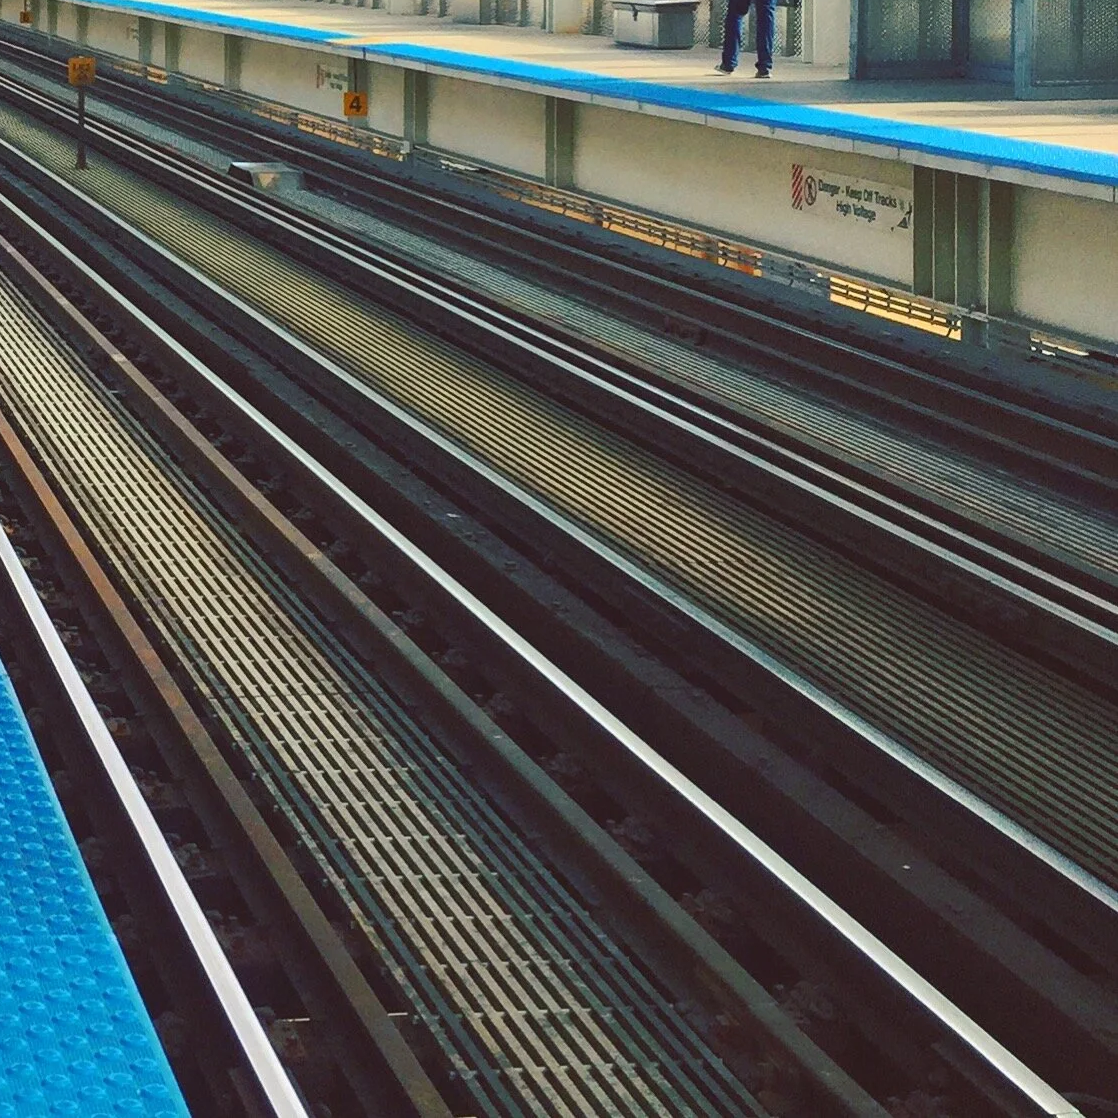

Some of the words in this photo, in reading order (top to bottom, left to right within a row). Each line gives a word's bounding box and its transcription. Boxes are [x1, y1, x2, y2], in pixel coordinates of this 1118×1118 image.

[349, 95, 362, 113] 4
[818, 179, 840, 197] Danger
[846, 185, 862, 202] Keep
[864, 189, 873, 202] Off
[874, 191, 897, 208] Tracks
[836, 200, 852, 217] High
